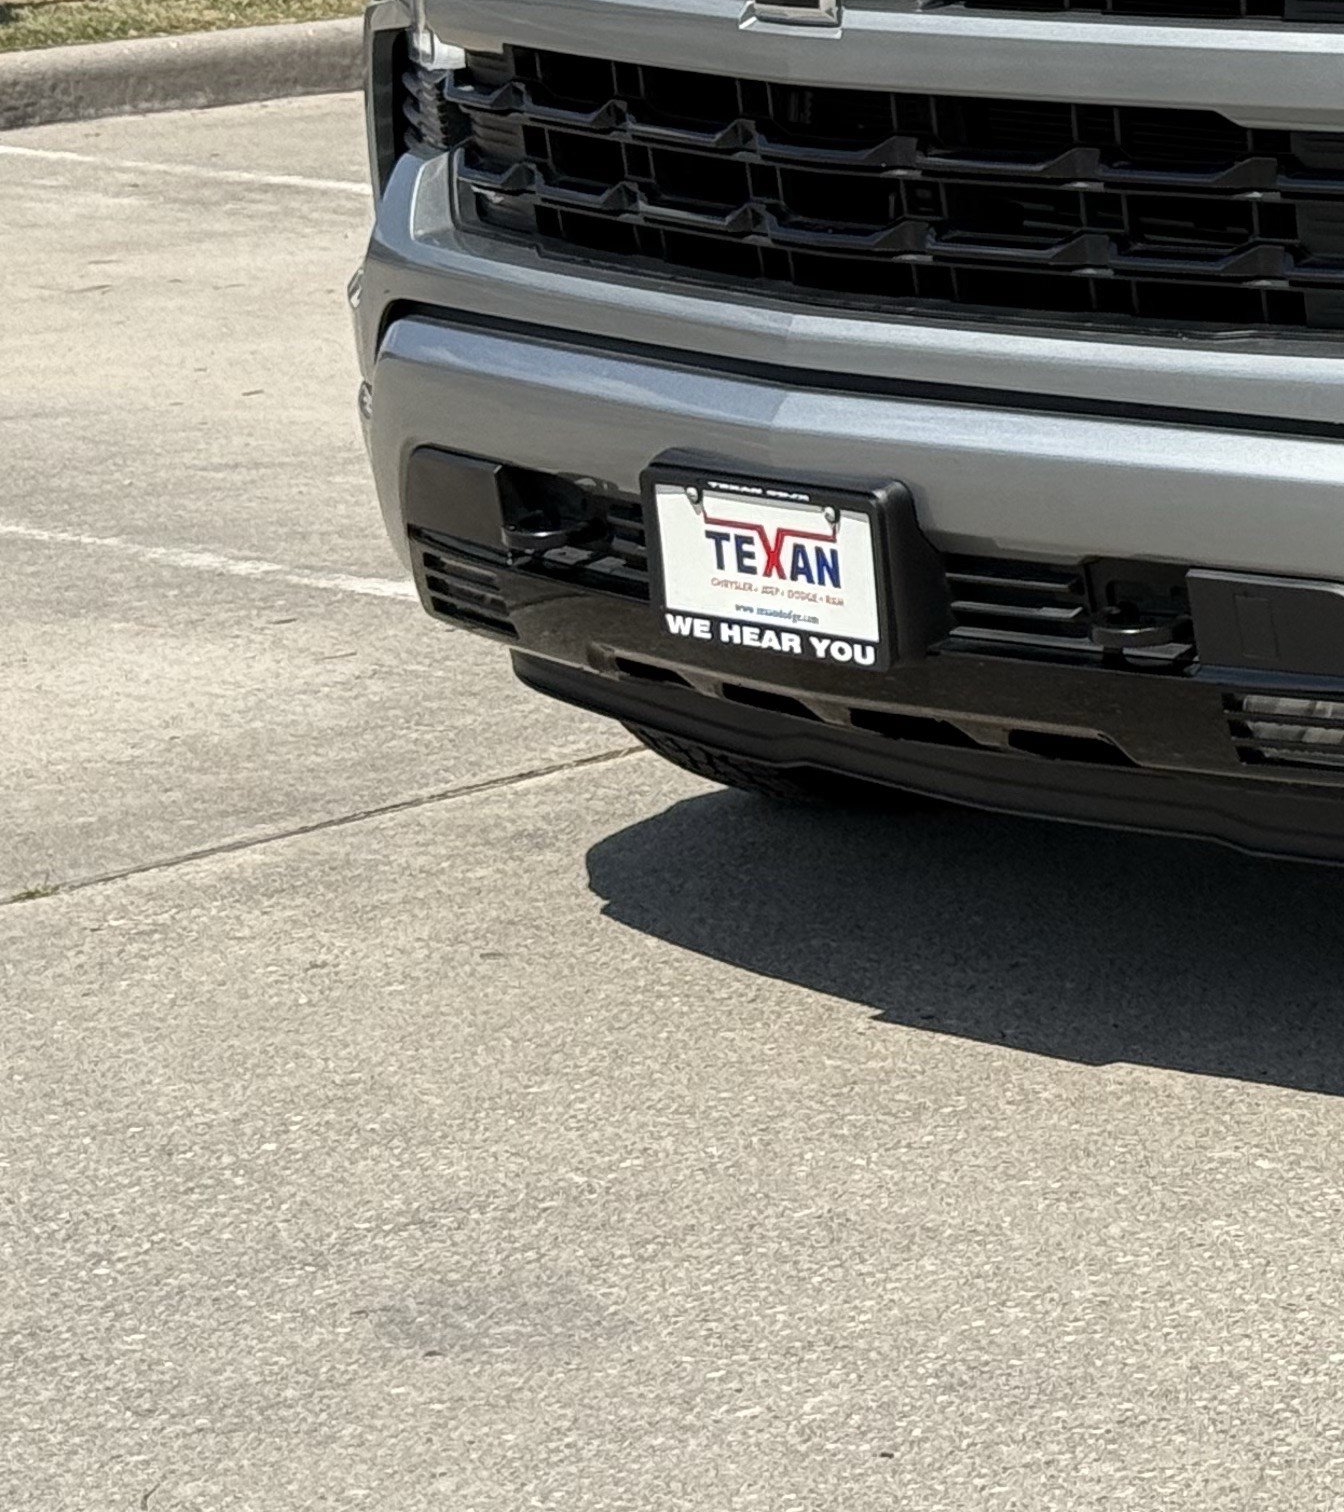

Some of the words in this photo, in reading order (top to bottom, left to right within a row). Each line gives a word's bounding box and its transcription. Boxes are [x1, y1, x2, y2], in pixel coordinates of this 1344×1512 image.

[703, 509, 842, 589] TEXAN
[665, 613, 712, 640] WE
[719, 622, 802, 654] HEAR
[809, 635, 876, 666] YOU
